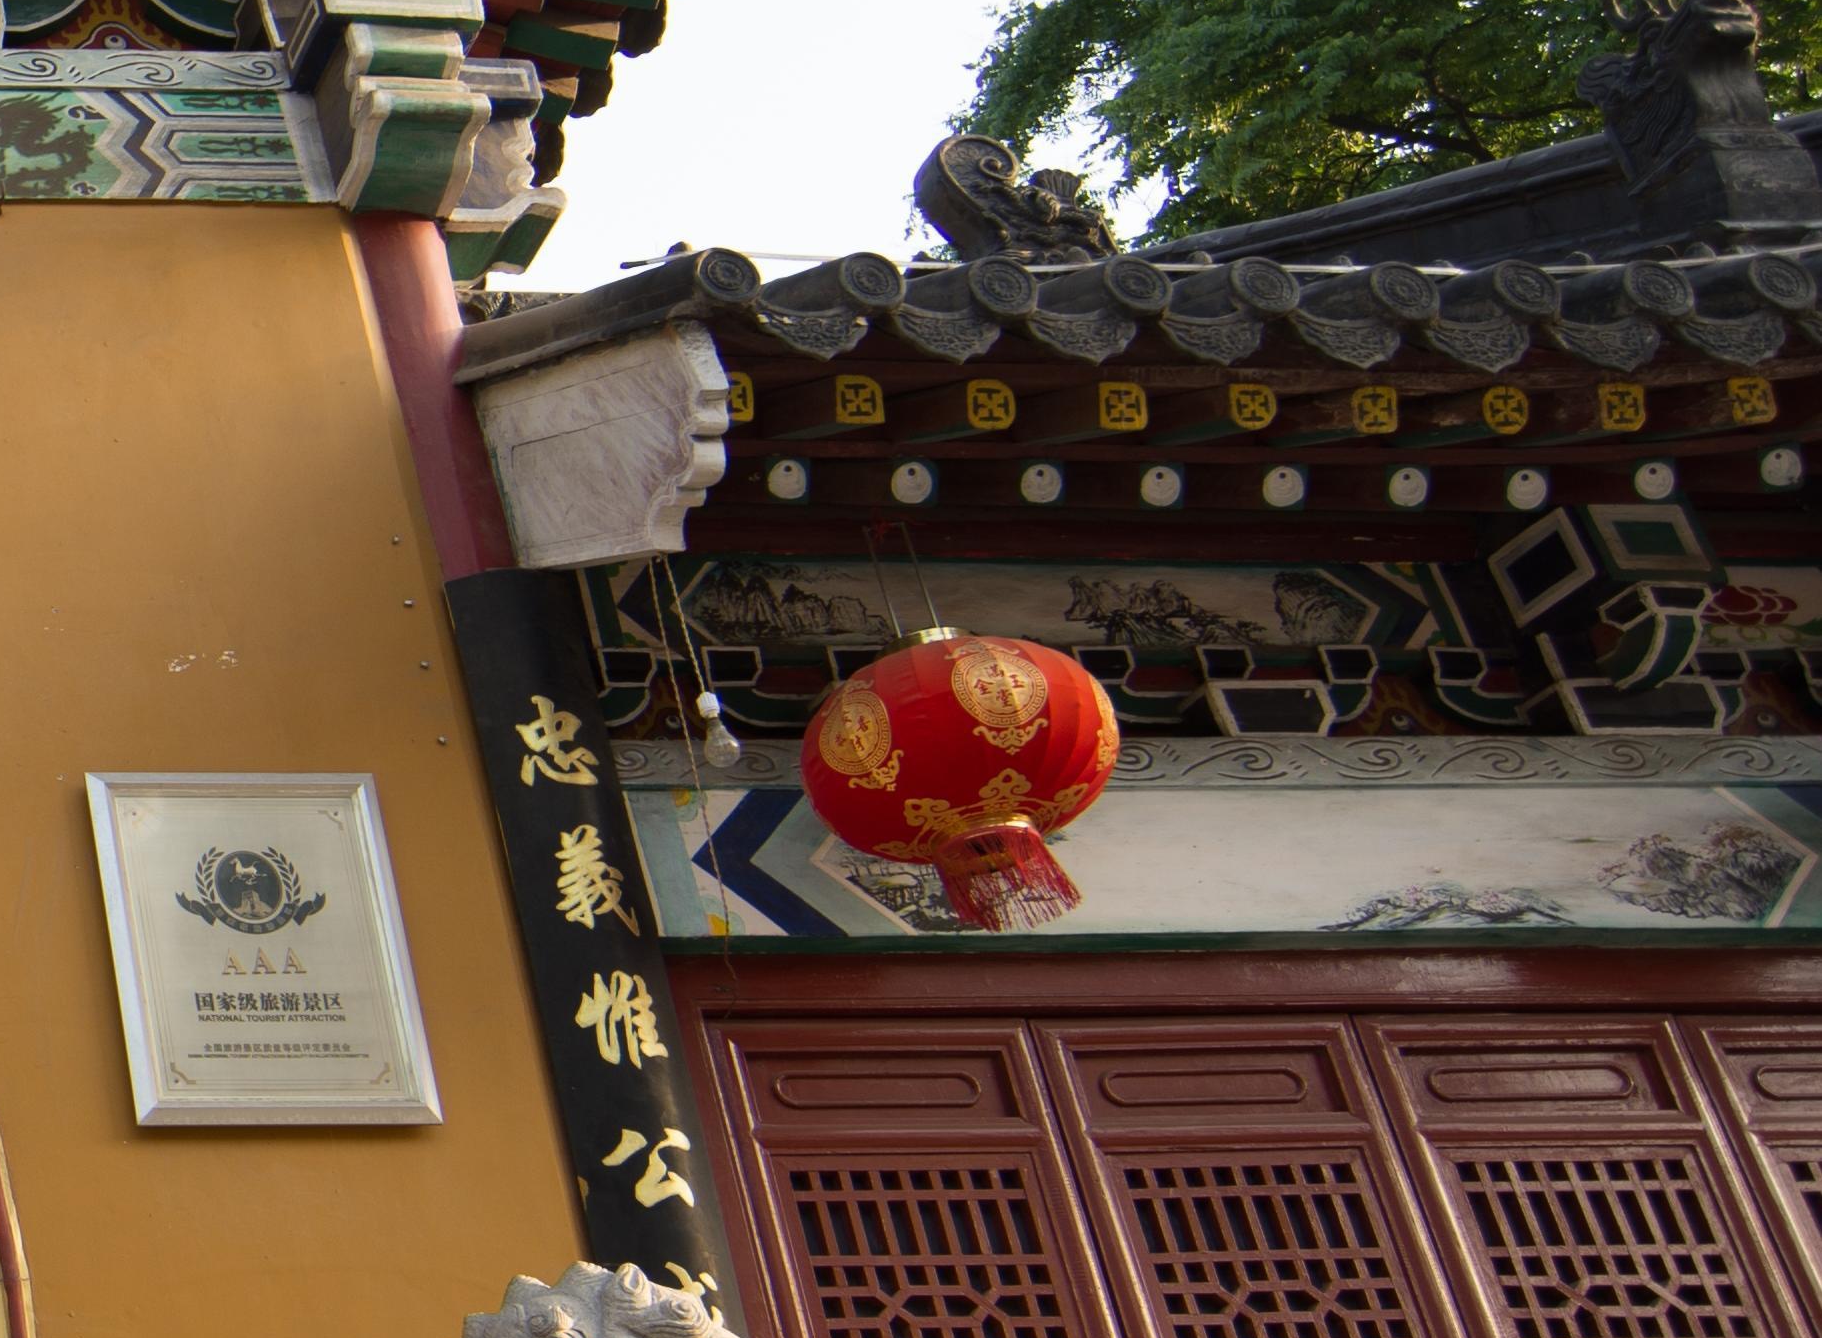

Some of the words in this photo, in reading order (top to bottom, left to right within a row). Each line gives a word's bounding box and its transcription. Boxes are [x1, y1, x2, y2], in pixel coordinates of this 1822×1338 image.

[194, 992, 344, 1012] 国家级旅游景区
[198, 1014, 244, 1023] NATIONAL
[247, 1014, 286, 1023] TOURIST
[288, 1014, 346, 1022] ATTRACTION
